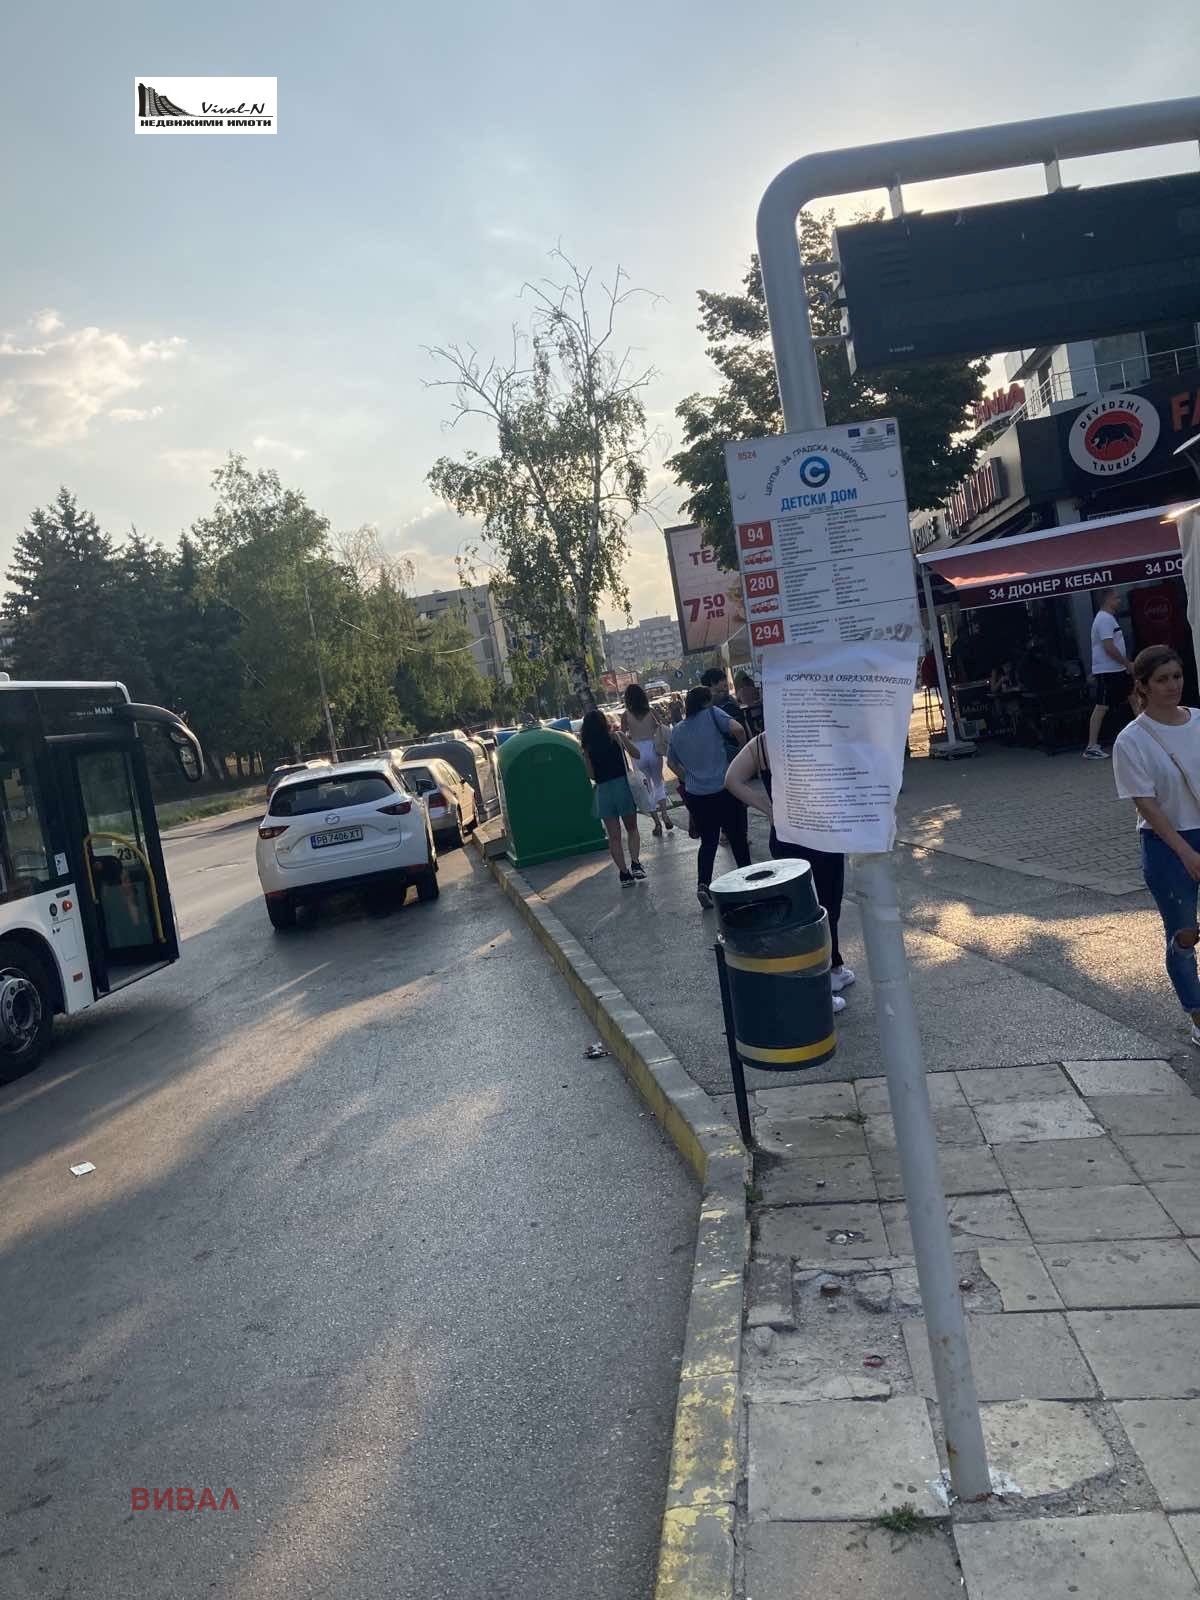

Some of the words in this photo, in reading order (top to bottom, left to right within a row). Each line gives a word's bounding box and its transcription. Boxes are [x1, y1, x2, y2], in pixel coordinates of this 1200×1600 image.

[1080, 400, 1141, 430] DEVEDZHI
[764, 465, 781, 496] ЦЕНТЪР
[780, 456, 792, 466] ЗА
[792, 444, 828, 456] ГРАДСКА
[831, 447, 868, 482] МОБИЛНОСТ
[1093, 452, 1137, 471] TAURUS
[781, 492, 826, 512] ДЕТСКИ
[831, 488, 858, 505] ДОМ
[747, 527, 764, 543] 94
[1145, 562, 1161, 575] 34
[750, 575, 774, 592] 280
[989, 588, 1005, 600] 34
[1008, 579, 1061, 599] ДЮНЕР
[1065, 570, 1113, 588] КЕБАП
[755, 624, 780, 640] 294
[95, 706, 113, 715] MAN
